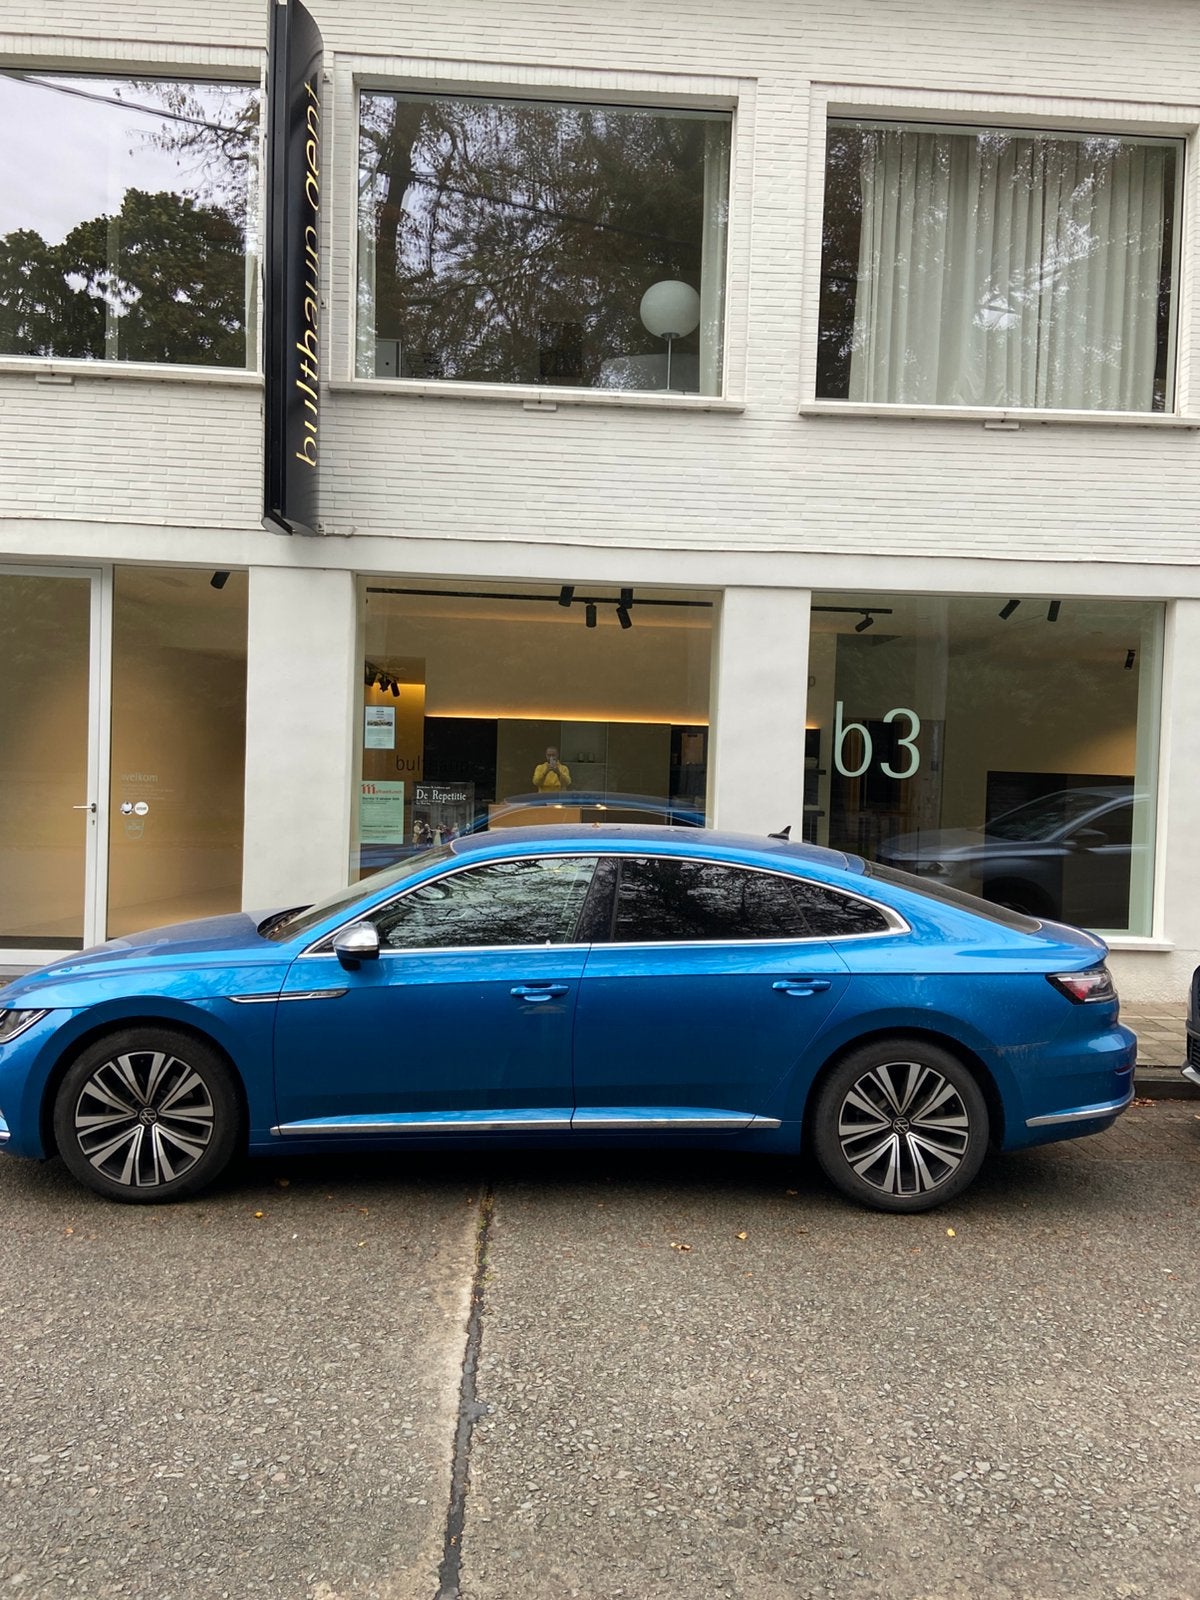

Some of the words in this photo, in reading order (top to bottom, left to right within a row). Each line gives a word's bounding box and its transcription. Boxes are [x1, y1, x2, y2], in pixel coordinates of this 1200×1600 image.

[834, 701, 921, 779] b3
[416, 788, 428, 800] De
[432, 789, 467, 804] Repetitie
